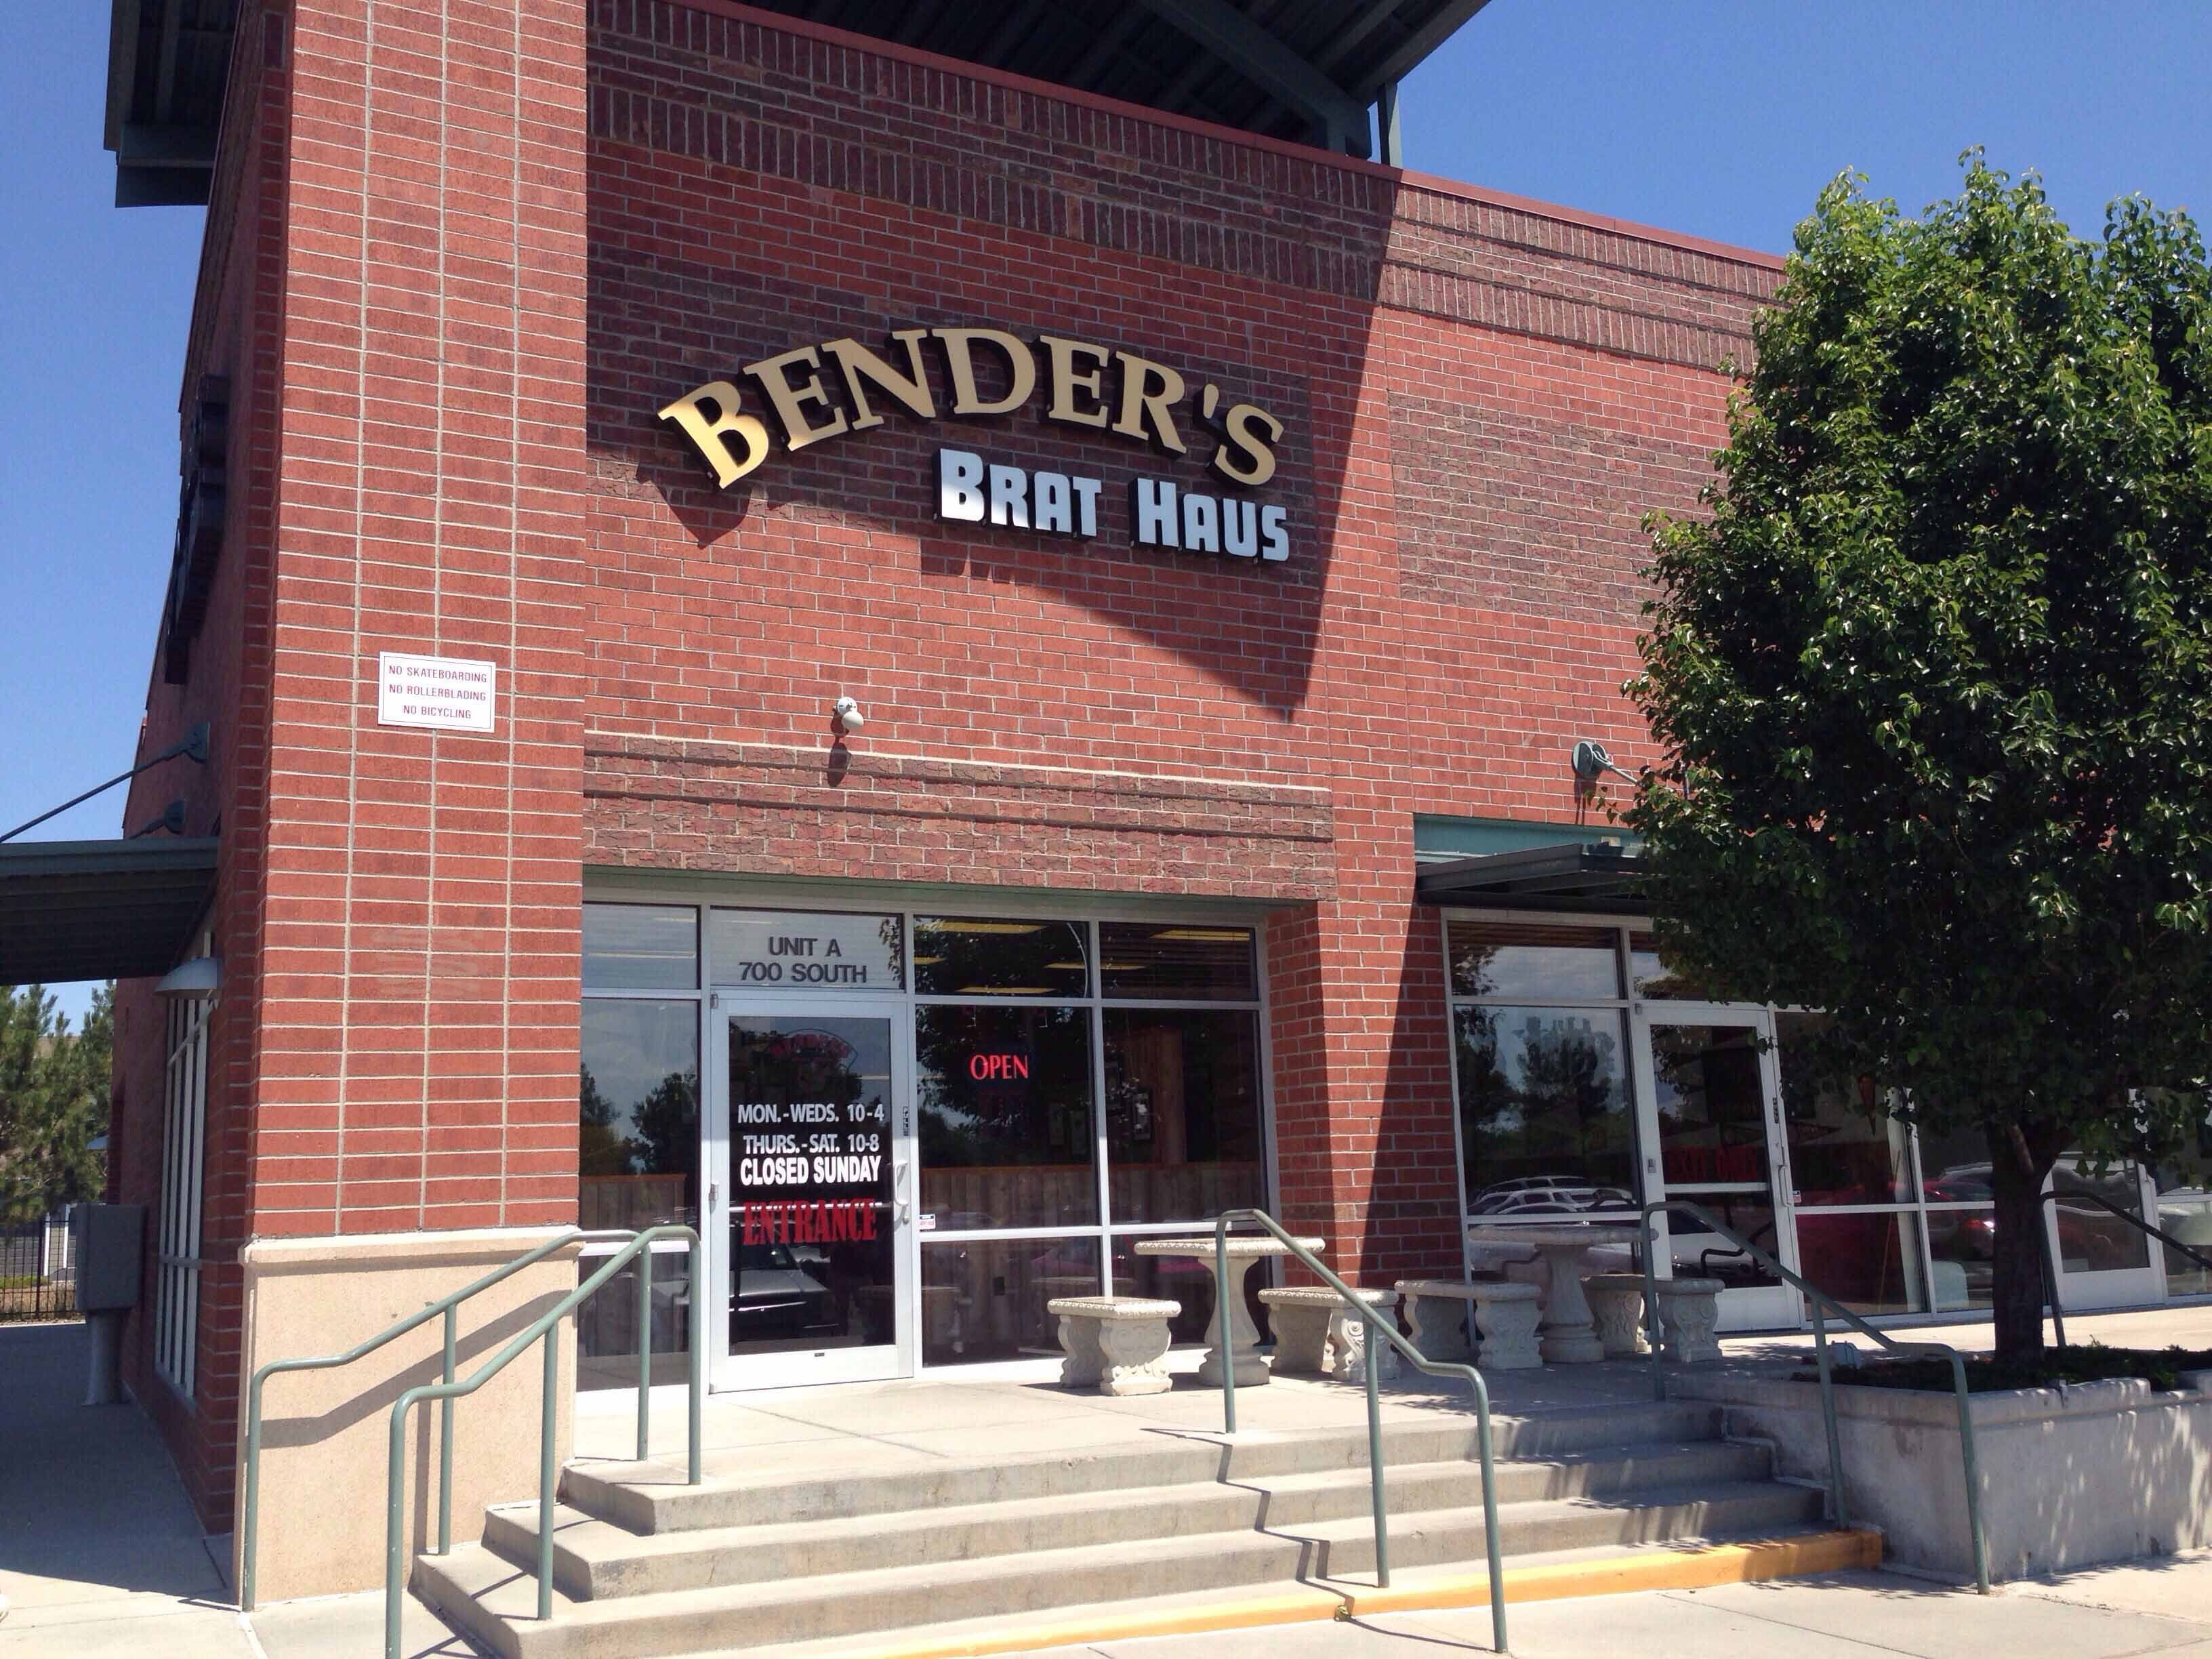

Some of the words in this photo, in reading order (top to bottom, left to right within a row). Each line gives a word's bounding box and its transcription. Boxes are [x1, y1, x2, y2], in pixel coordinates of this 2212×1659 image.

[657, 328, 1284, 490] BENDER'S
[938, 447, 1101, 537] BRAT
[1137, 477, 1289, 562] HAUS
[389, 665, 403, 675] NO
[407, 667, 487, 683] SKATEBOARDING
[389, 684, 403, 694] NO
[407, 685, 487, 701] ROLLERBLADING
[403, 705, 417, 715] NO
[421, 707, 472, 719] BICYCLING
[768, 936, 819, 956] UNIT
[825, 939, 842, 957] A
[739, 962, 783, 981] 700
[791, 963, 867, 983] SOUTH
[969, 1054, 1029, 1080] OPEN
[847, 1134, 880, 1153] 10-8
[740, 1157, 809, 1186] CLOSED
[813, 1155, 881, 1184] SUNDAY
[743, 1198, 878, 1246] ENTRANCE
